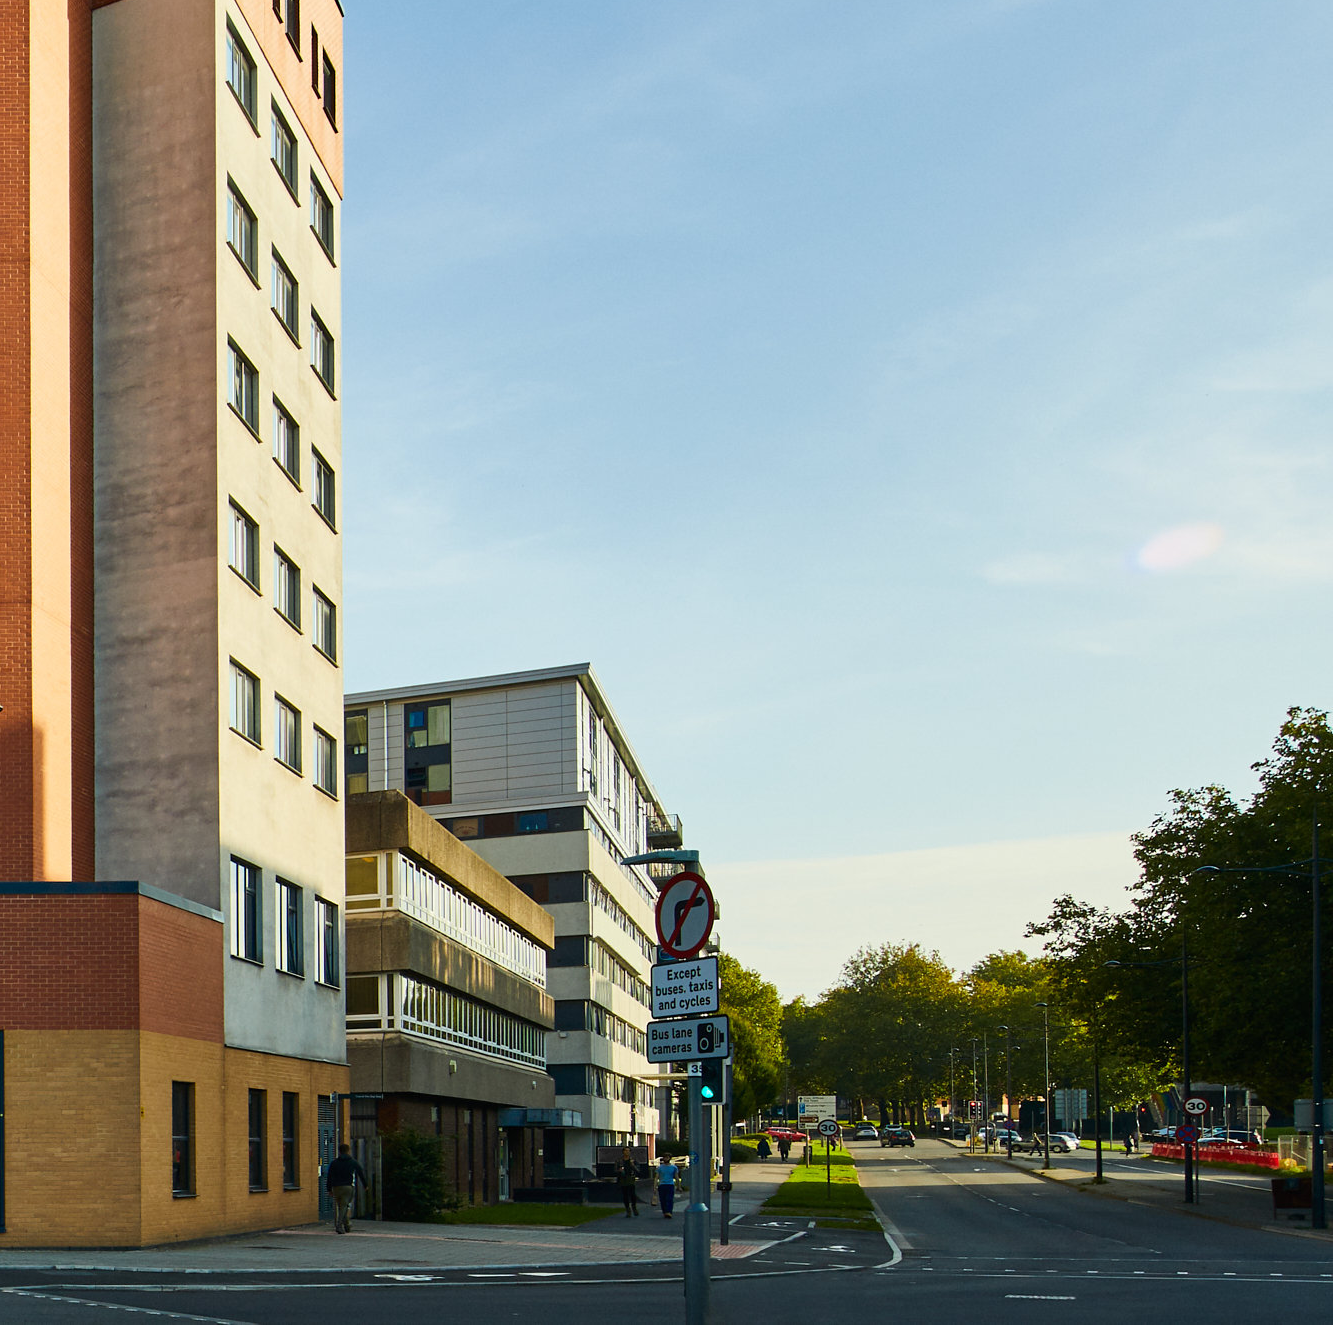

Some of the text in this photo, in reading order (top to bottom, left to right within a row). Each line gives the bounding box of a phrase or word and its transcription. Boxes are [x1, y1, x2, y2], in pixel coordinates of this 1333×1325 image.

[667, 966, 701, 980] Except
[689, 979, 713, 992] taxis
[659, 995, 710, 1010] and cycles
[652, 1028, 692, 1040] Bus lane
[652, 1043, 692, 1054] cameras
